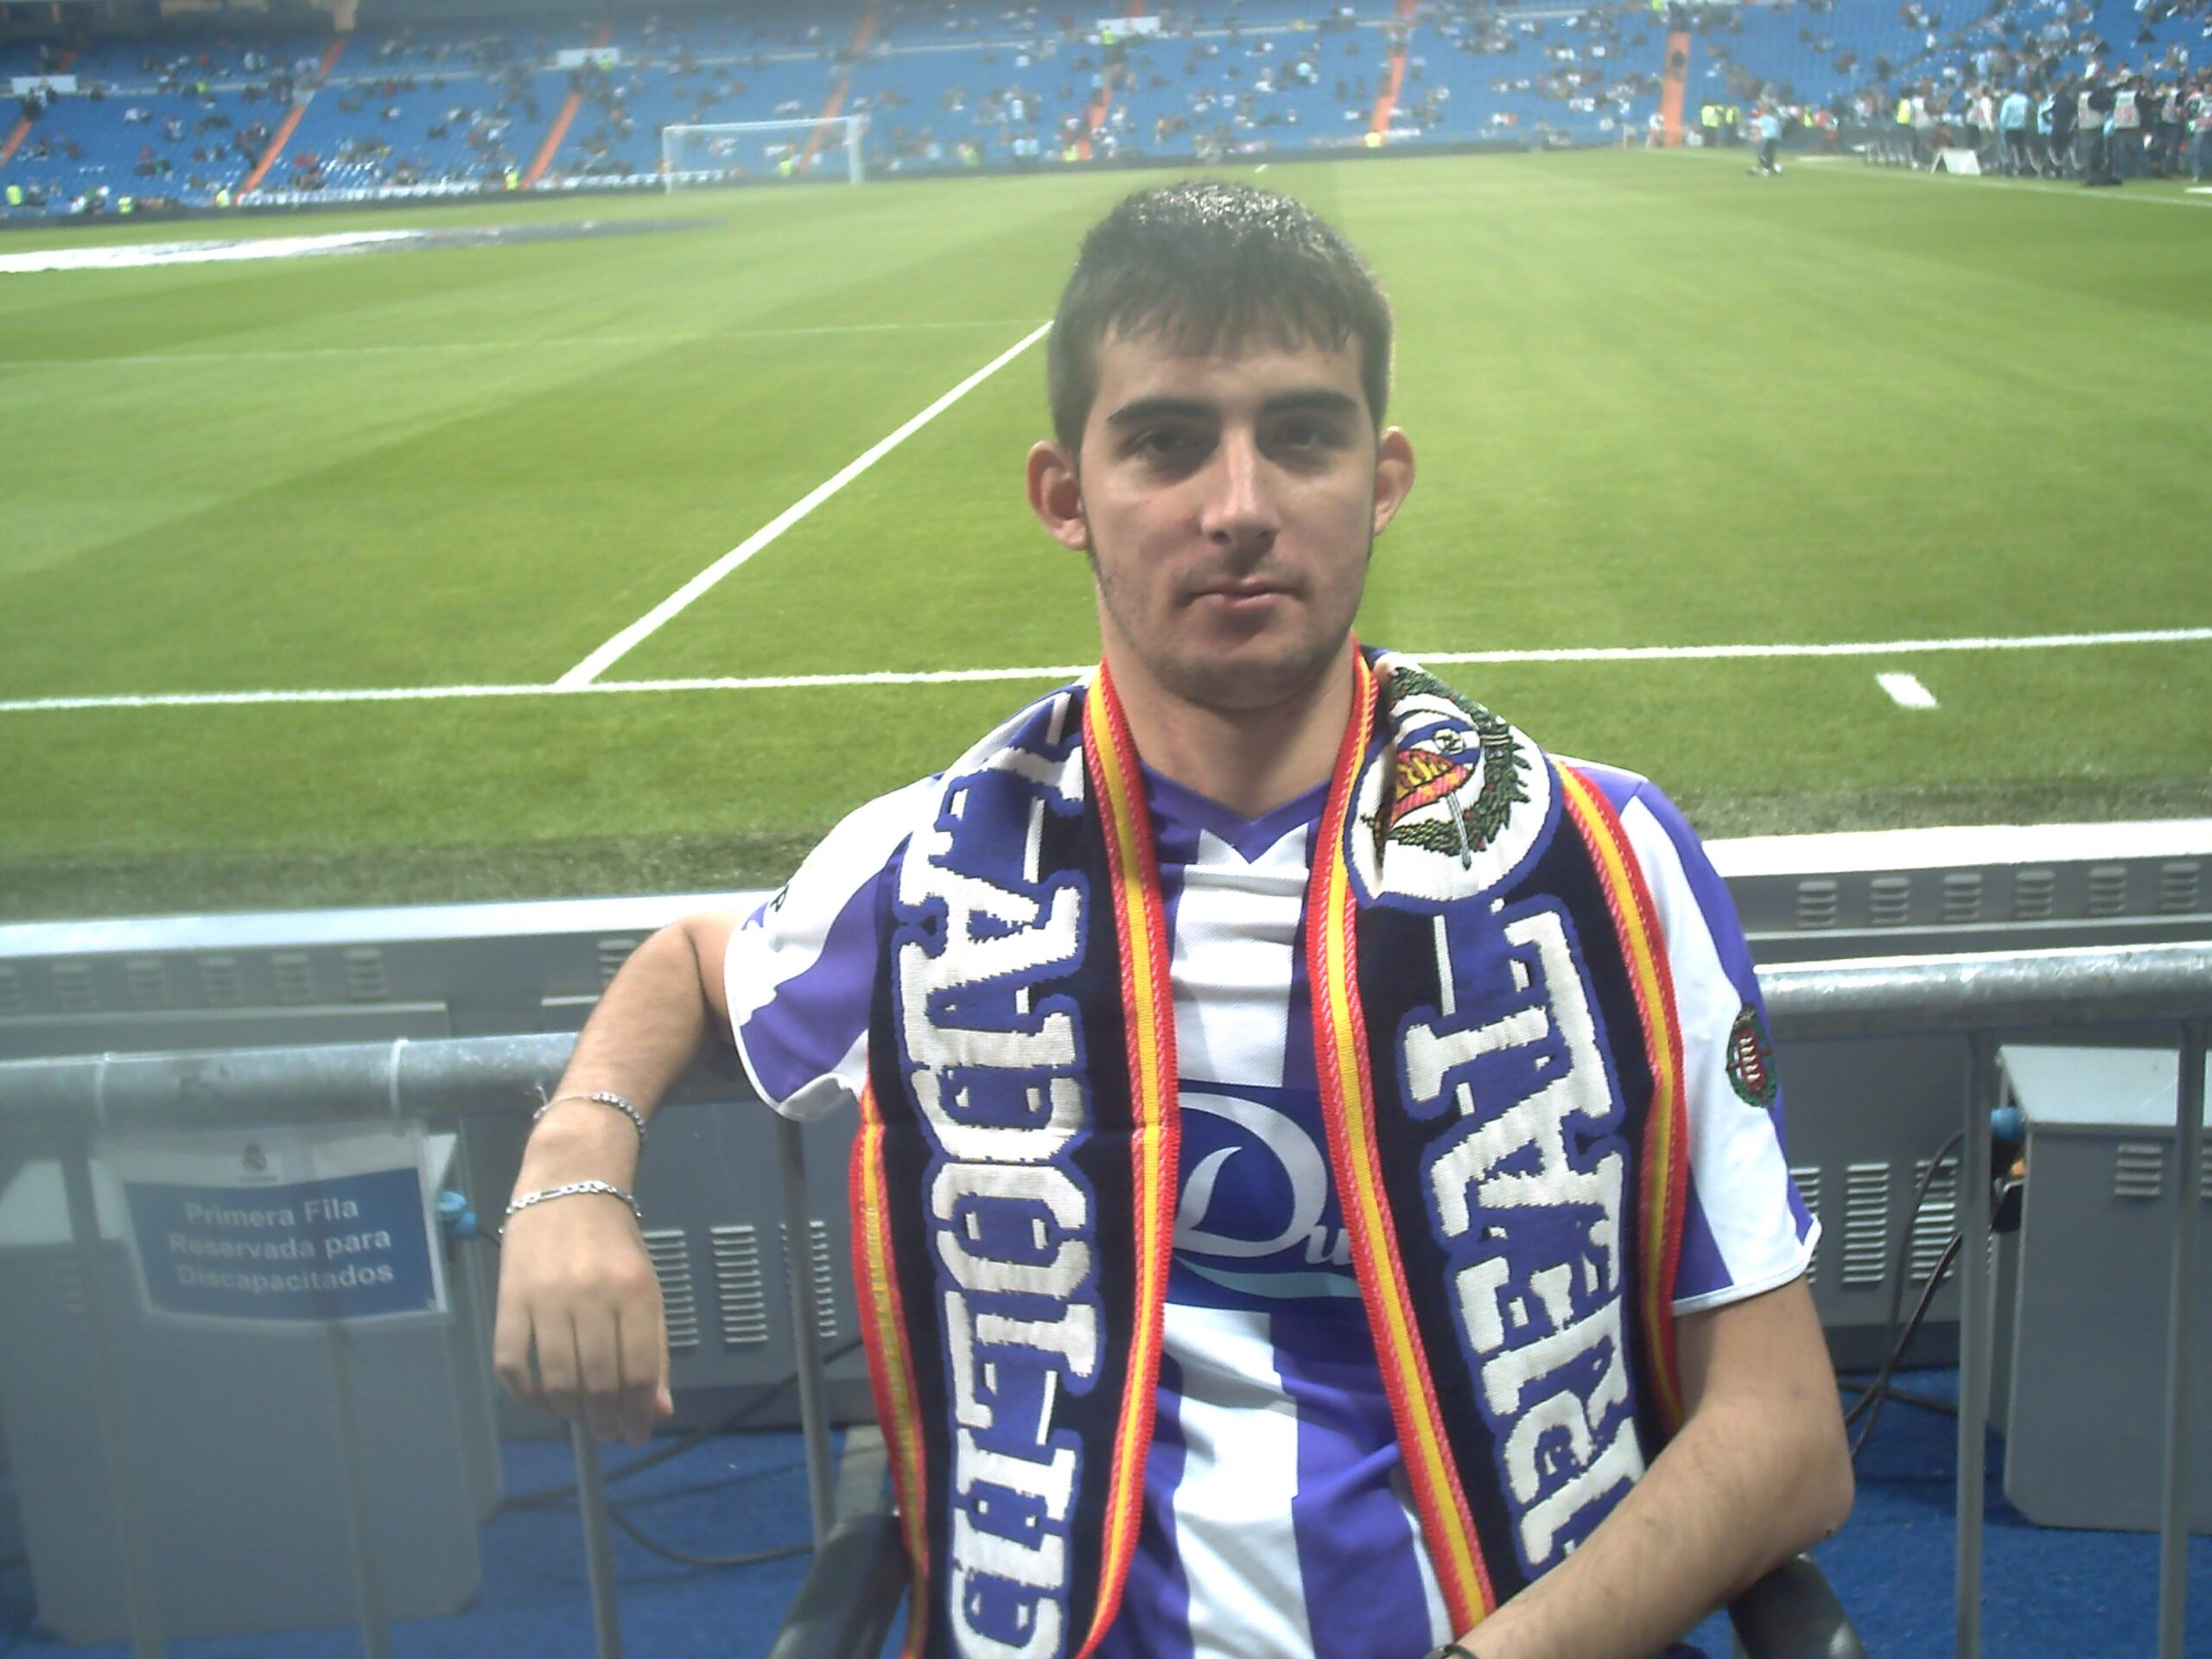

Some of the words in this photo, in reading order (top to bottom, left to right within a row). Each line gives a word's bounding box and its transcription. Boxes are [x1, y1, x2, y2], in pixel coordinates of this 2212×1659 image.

[184, 1201, 295, 1228] Primera
[304, 1198, 359, 1224] Fila
[169, 1231, 315, 1260] Reservada
[325, 1229, 391, 1261] para
[1405, 912, 1643, 1565] REAL
[176, 1262, 395, 1293] Discapacitados
